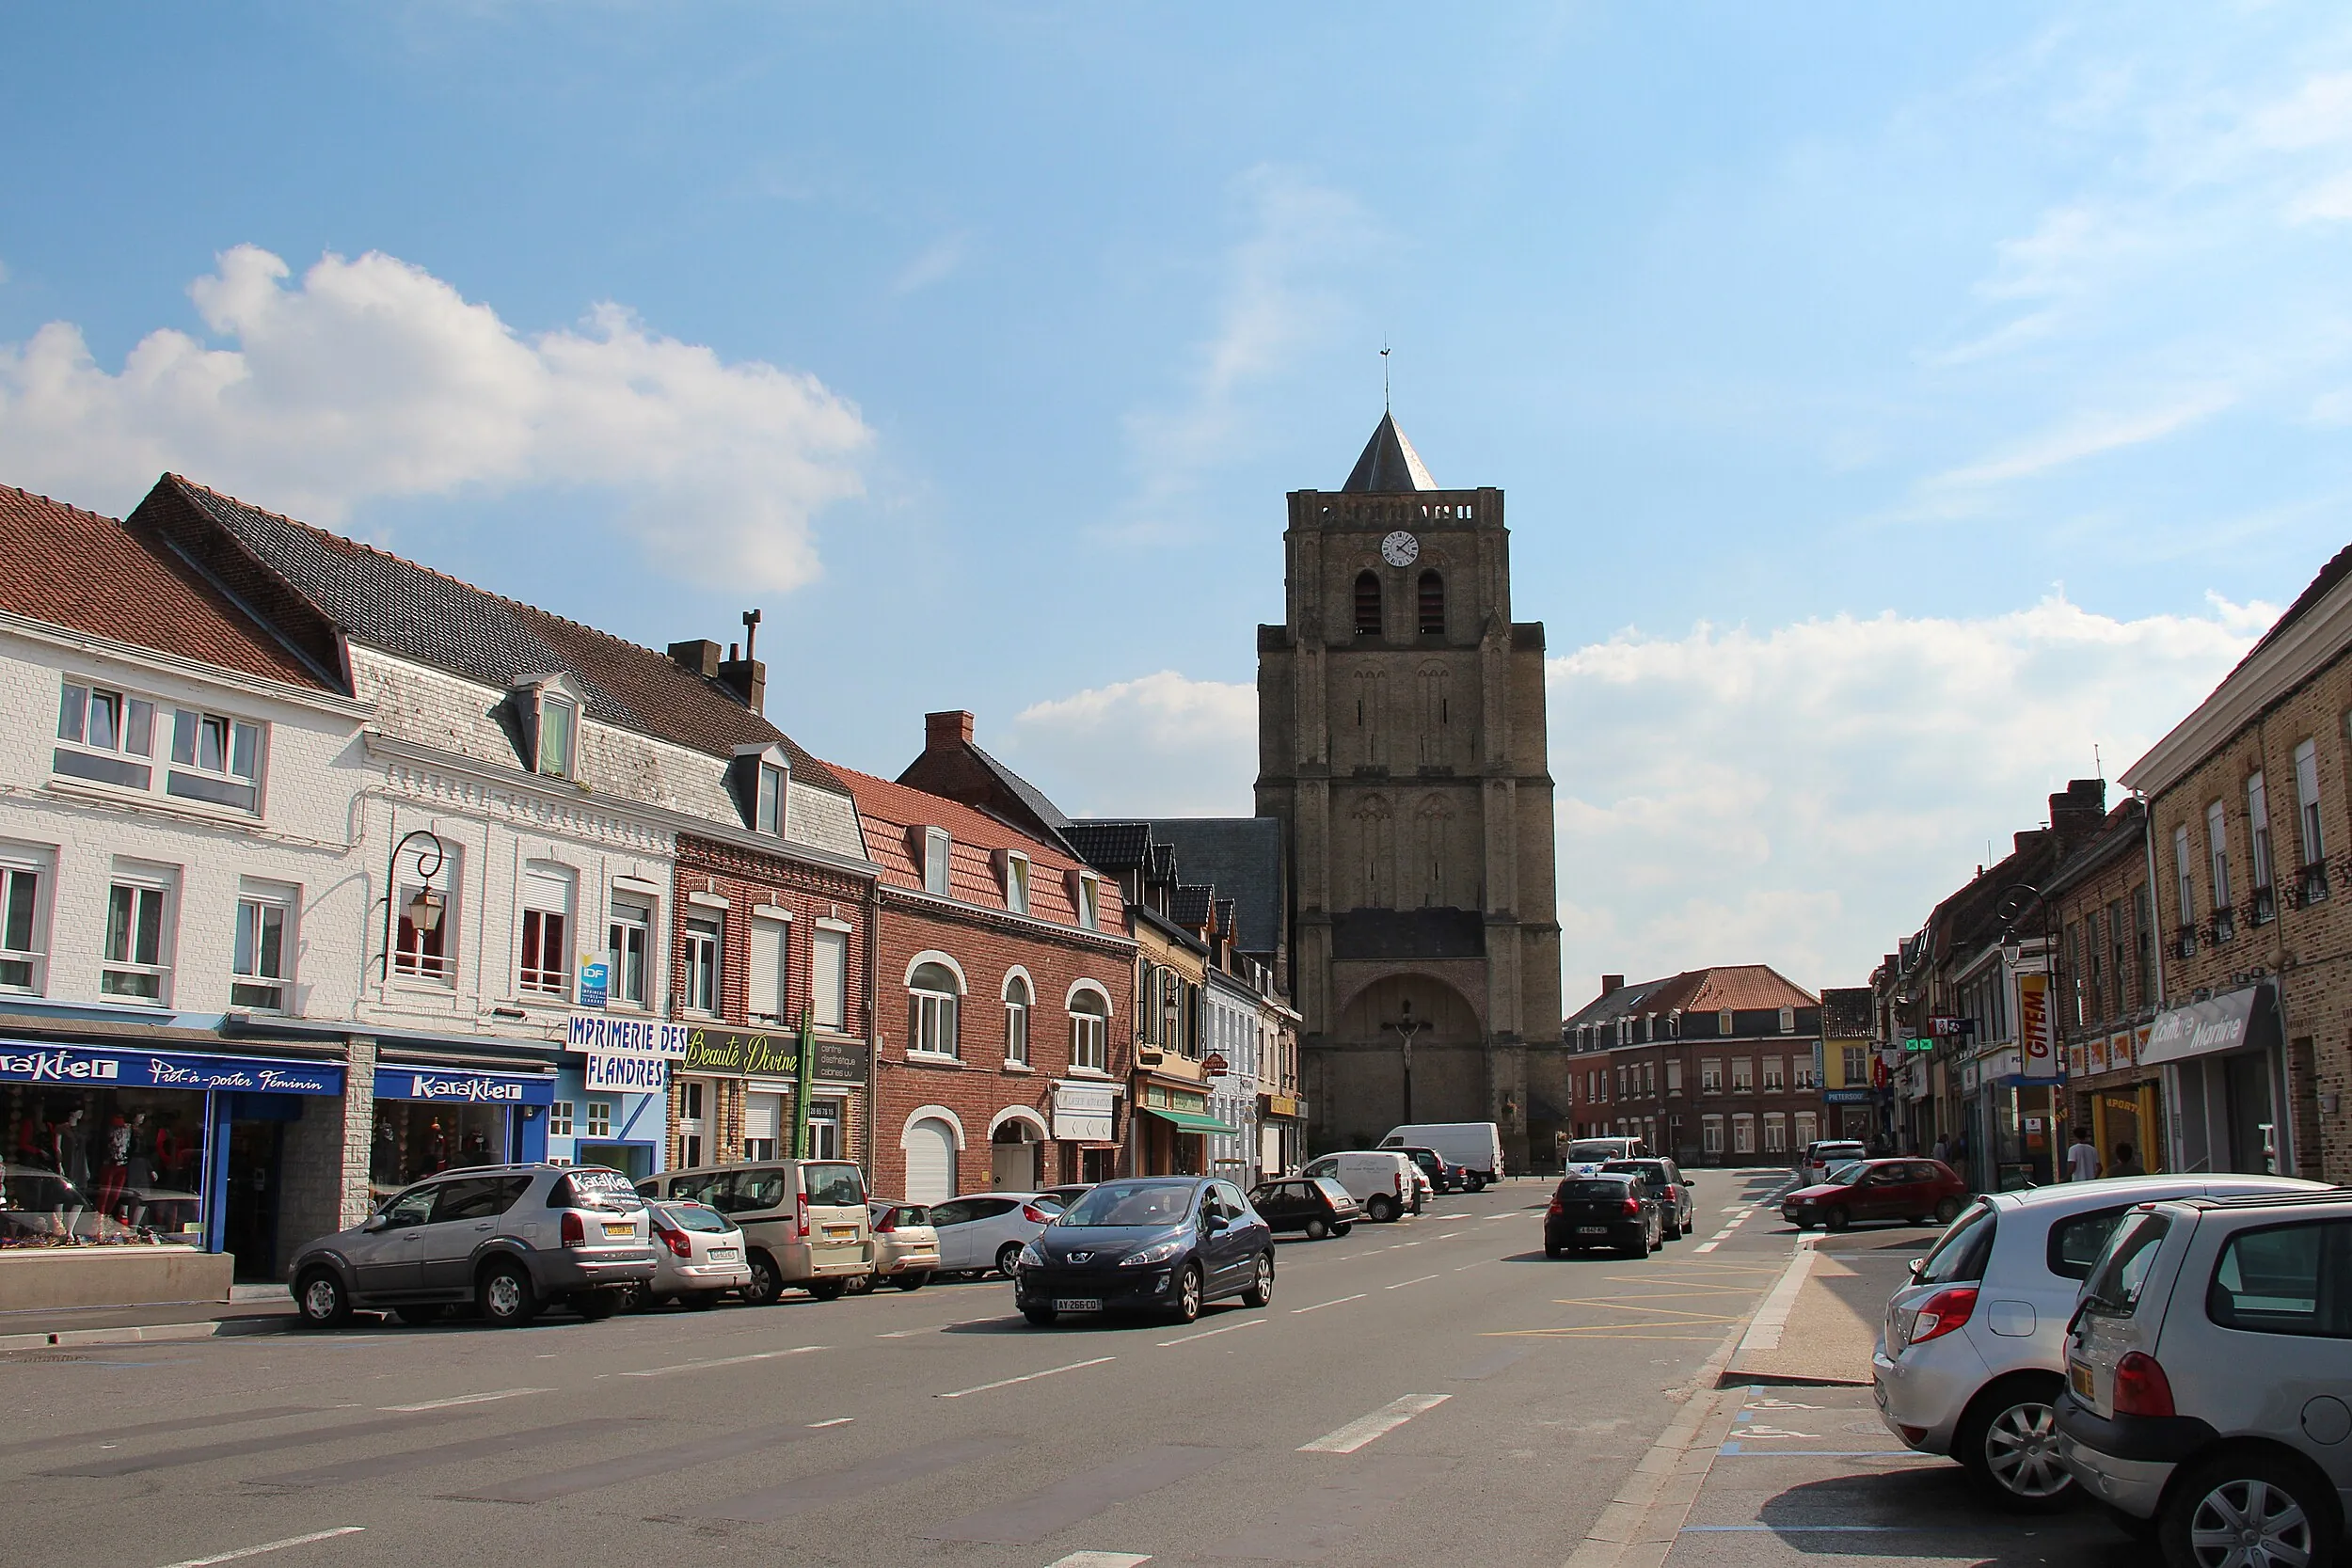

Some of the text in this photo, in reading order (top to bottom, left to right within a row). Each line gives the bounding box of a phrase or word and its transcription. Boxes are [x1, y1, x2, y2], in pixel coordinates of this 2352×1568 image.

[568, 1016, 686, 1053] IMPRIMERIE DES
[2024, 990, 2049, 1058] GITEM
[2152, 1013, 2194, 1043] Coiffure
[2189, 1015, 2242, 1049] Martine
[0, 1051, 119, 1081] rakter
[680, 1026, 798, 1077] Beauté Divine
[258, 1069, 323, 1091] Féminin
[588, 1055, 663, 1089] FLANDRES
